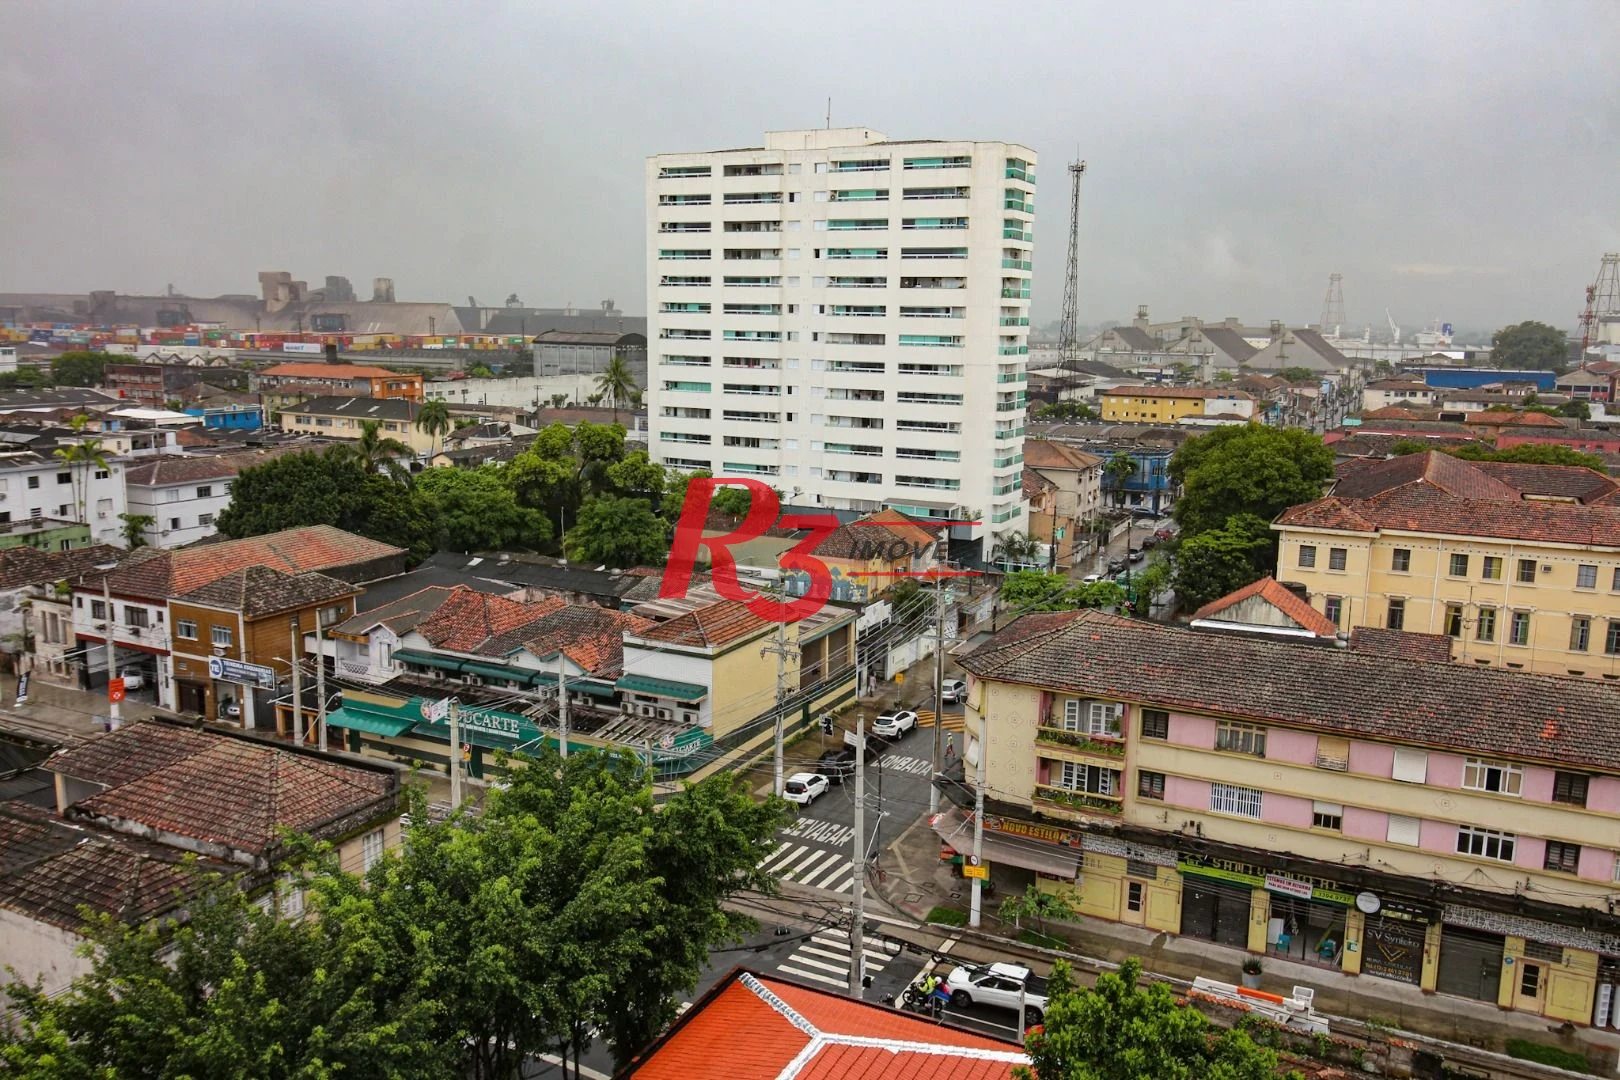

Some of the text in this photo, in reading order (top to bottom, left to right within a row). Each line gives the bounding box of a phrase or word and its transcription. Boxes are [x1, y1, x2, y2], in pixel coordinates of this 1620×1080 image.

[870, 753, 934, 777] LOMBADA
[781, 817, 856, 847] DEVAGAR
[1002, 820, 1027, 833] NOVO
